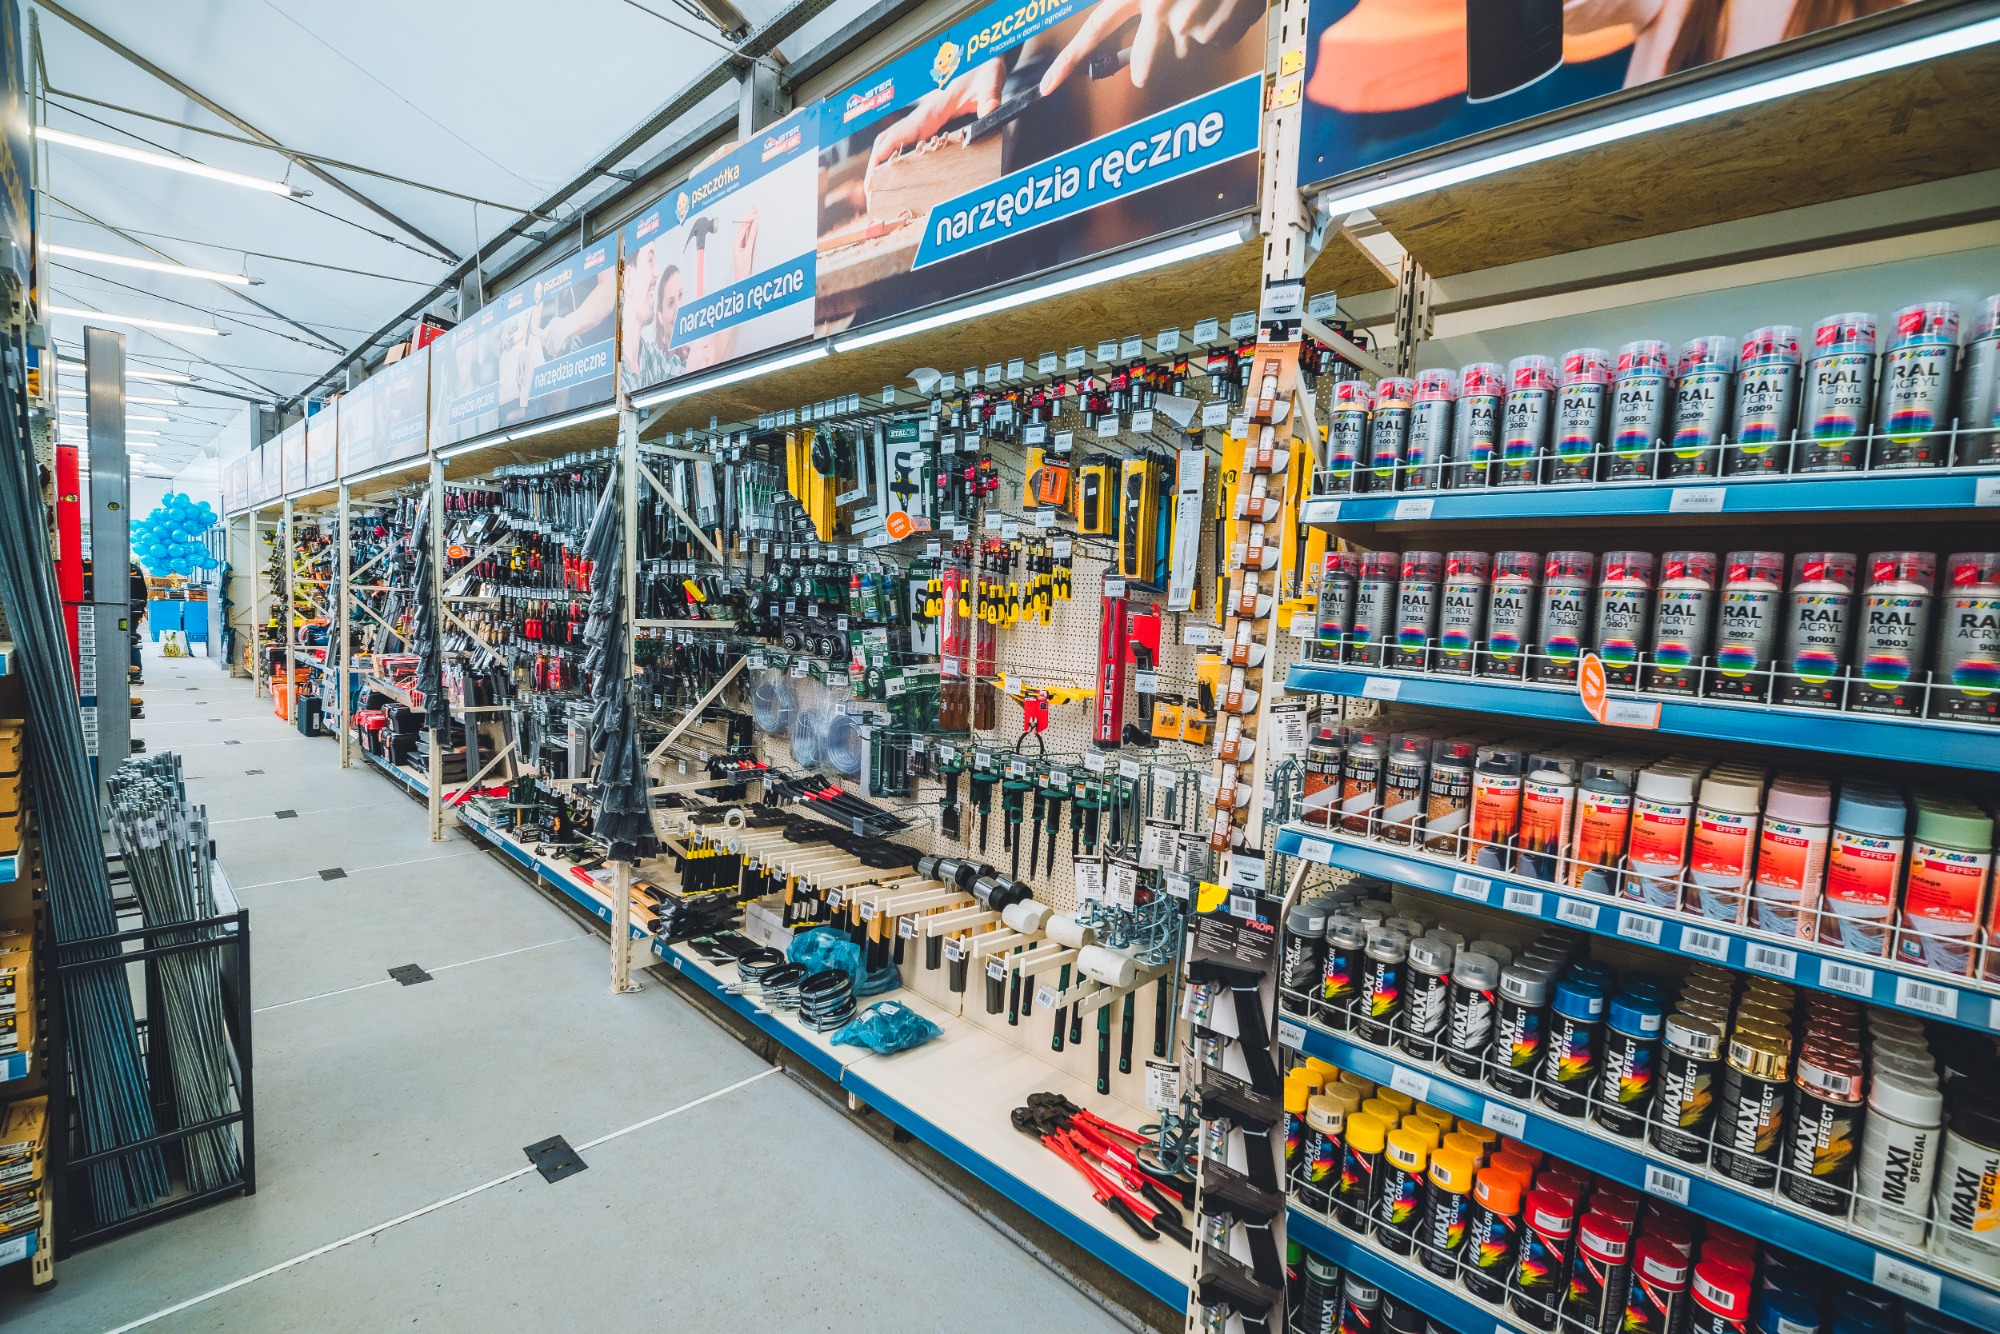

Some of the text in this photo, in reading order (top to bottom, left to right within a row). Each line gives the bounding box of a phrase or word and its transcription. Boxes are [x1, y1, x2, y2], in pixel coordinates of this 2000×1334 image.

[936, 111, 1225, 246] narzędzia ręczne
[691, 164, 740, 208] pszczółka
[679, 268, 804, 335] narzędzia ręczne
[534, 351, 607, 389] narzędzia ręczne
[1893, 362, 1939, 380] RAL
[1818, 370, 1861, 385] RAL
[1890, 377, 1938, 390] ACRYL
[1679, 388, 1714, 403] RAL
[1743, 381, 1783, 396] RAL
[1818, 384, 1860, 395] ACRYL
[1564, 398, 1596, 410] RAL
[1620, 391, 1654, 403] RAL
[1508, 403, 1538, 415] RAL
[1562, 408, 1595, 418] ACRYL
[1618, 402, 1653, 413] ACRYL
[1376, 420, 1402, 430] RAL
[1507, 413, 1537, 424] ACRYL
[1334, 422, 1358, 432] RAL
[1375, 430, 1400, 438] ACRYL
[1333, 432, 1358, 440] ACRYL
[1322, 592, 1345, 602] RAL
[1402, 595, 1429, 605] RAL
[1446, 597, 1473, 607] RAL
[1494, 598, 1523, 609] RAL
[1321, 602, 1344, 610] ACRYL
[1401, 605, 1428, 613] ACRYL
[1445, 606, 1473, 615] ACRYL
[1551, 600, 1583, 612] RAL
[1606, 602, 1640, 614] RAL
[1660, 604, 1696, 616] RAL
[1724, 606, 1762, 618] RAL
[1493, 609, 1522, 618] ACRYL
[1549, 611, 1582, 621] ACRYL
[1604, 614, 1639, 622] ACRYL
[1659, 616, 1695, 625] ACRYL
[1800, 609, 1842, 624] RAL
[1870, 612, 1916, 626] RAL
[1722, 618, 1761, 628] ACRYL
[1799, 622, 1842, 633] ACRYL
[1868, 625, 1916, 636] ACRYL
[1877, 639, 1908, 647] 9003
[1954, 714, 1989, 722] PROTECTION
[1356, 770, 1375, 780] STOP
[1399, 777, 1418, 788] STOP
[1431, 782, 1469, 796] RUST STOP
[1538, 795, 1562, 803] EFFECT
[1658, 816, 1684, 825] EFFECT
[1716, 825, 1746, 835] EFFECT
[1775, 835, 1805, 846] EFFECT
[1860, 851, 1894, 860] EFFECT
[1946, 866, 1980, 876] EFFECT
[1911, 875, 1941, 887] Vintage
[1294, 938, 1302, 966] COLOR
[1284, 947, 1295, 986] MAXI
[1375, 964, 1385, 993] COLOR
[1362, 972, 1374, 1015] MAXI
[1428, 978, 1437, 1009] COLOR
[1410, 989, 1428, 1032] MAXI
[1468, 992, 1479, 1024] COLOR
[1452, 1003, 1469, 1049] MAXI
[1514, 1007, 1527, 1044] EFFECT
[1498, 1018, 1515, 1066] MAXI
[1562, 1020, 1574, 1059] EFFECT
[1547, 1031, 1563, 1081] MAXI
[1622, 1039, 1636, 1079] EFFECT
[1604, 1050, 1624, 1102] MAXI
[1683, 1060, 1698, 1102] EFFECT
[1662, 1072, 1685, 1126] MAXI
[1759, 1084, 1775, 1127] EFFECT
[1735, 1097, 1761, 1153] MAXI
[1817, 1104, 1834, 1149] EFFECT
[1314, 1133, 1322, 1161] COLOR
[1794, 1115, 1819, 1174] MAXI
[1303, 1140, 1315, 1181] MAXI
[1909, 1134, 1926, 1183] SPECIAL
[1882, 1145, 1912, 1205] MAXI
[1394, 1171, 1404, 1200] COLOR
[1979, 1159, 2000, 1210] SPECIAL
[1382, 1177, 1396, 1222] MAXI
[1950, 1166, 1981, 1231] MAXI
[1450, 1195, 1460, 1225] COLOR
[1433, 1204, 1450, 1249] MAXI
[1482, 1211, 1493, 1244] COLOR
[1469, 1217, 1484, 1265] MAXI
[1523, 1228, 1532, 1261] COLOR
